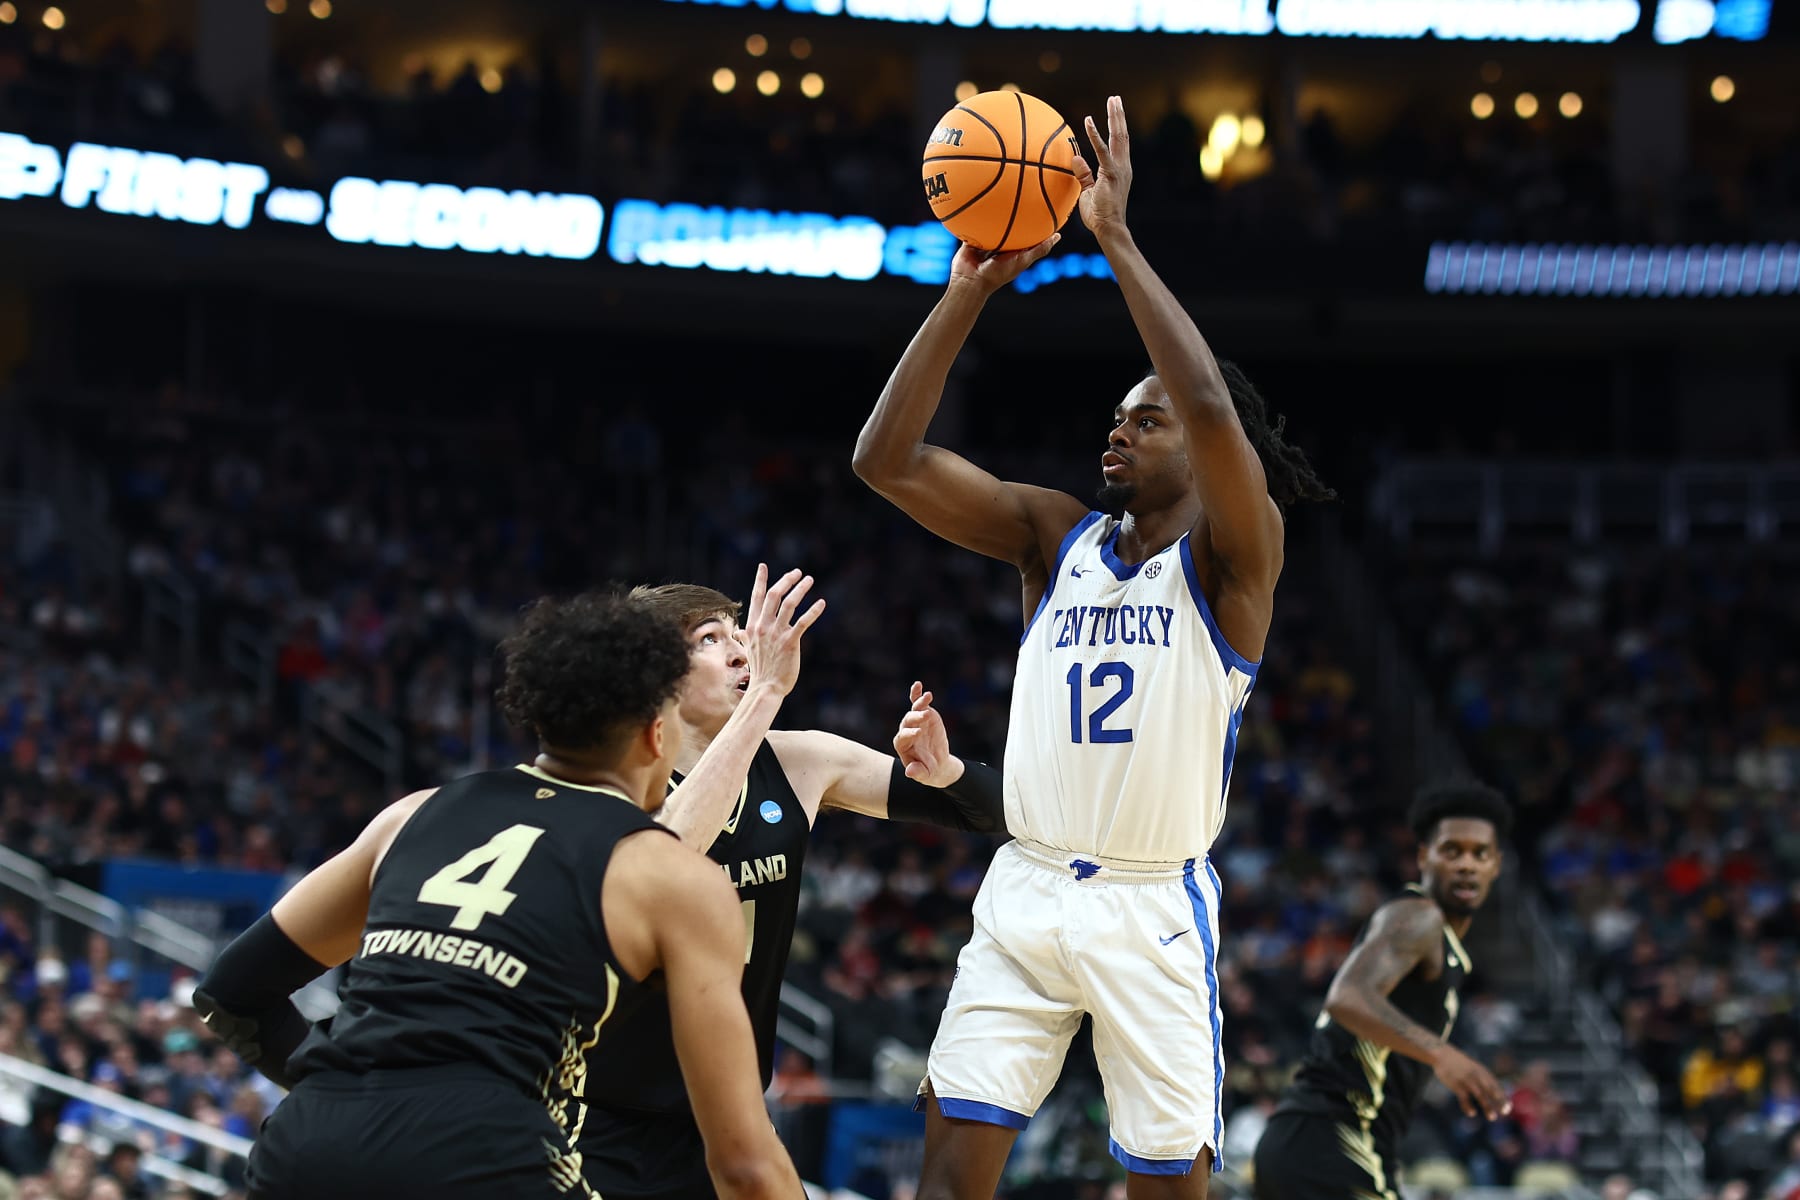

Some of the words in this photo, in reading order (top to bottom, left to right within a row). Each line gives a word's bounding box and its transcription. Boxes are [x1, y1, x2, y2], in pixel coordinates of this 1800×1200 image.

[61, 142, 269, 229] FIRST
[326, 176, 604, 260] SECOND
[1145, 562, 1162, 579] SEC
[1067, 662, 1134, 744] 12
[417, 824, 546, 931] 4
[720, 854, 787, 888] LAND
[361, 930, 528, 989] TOWNSEND
